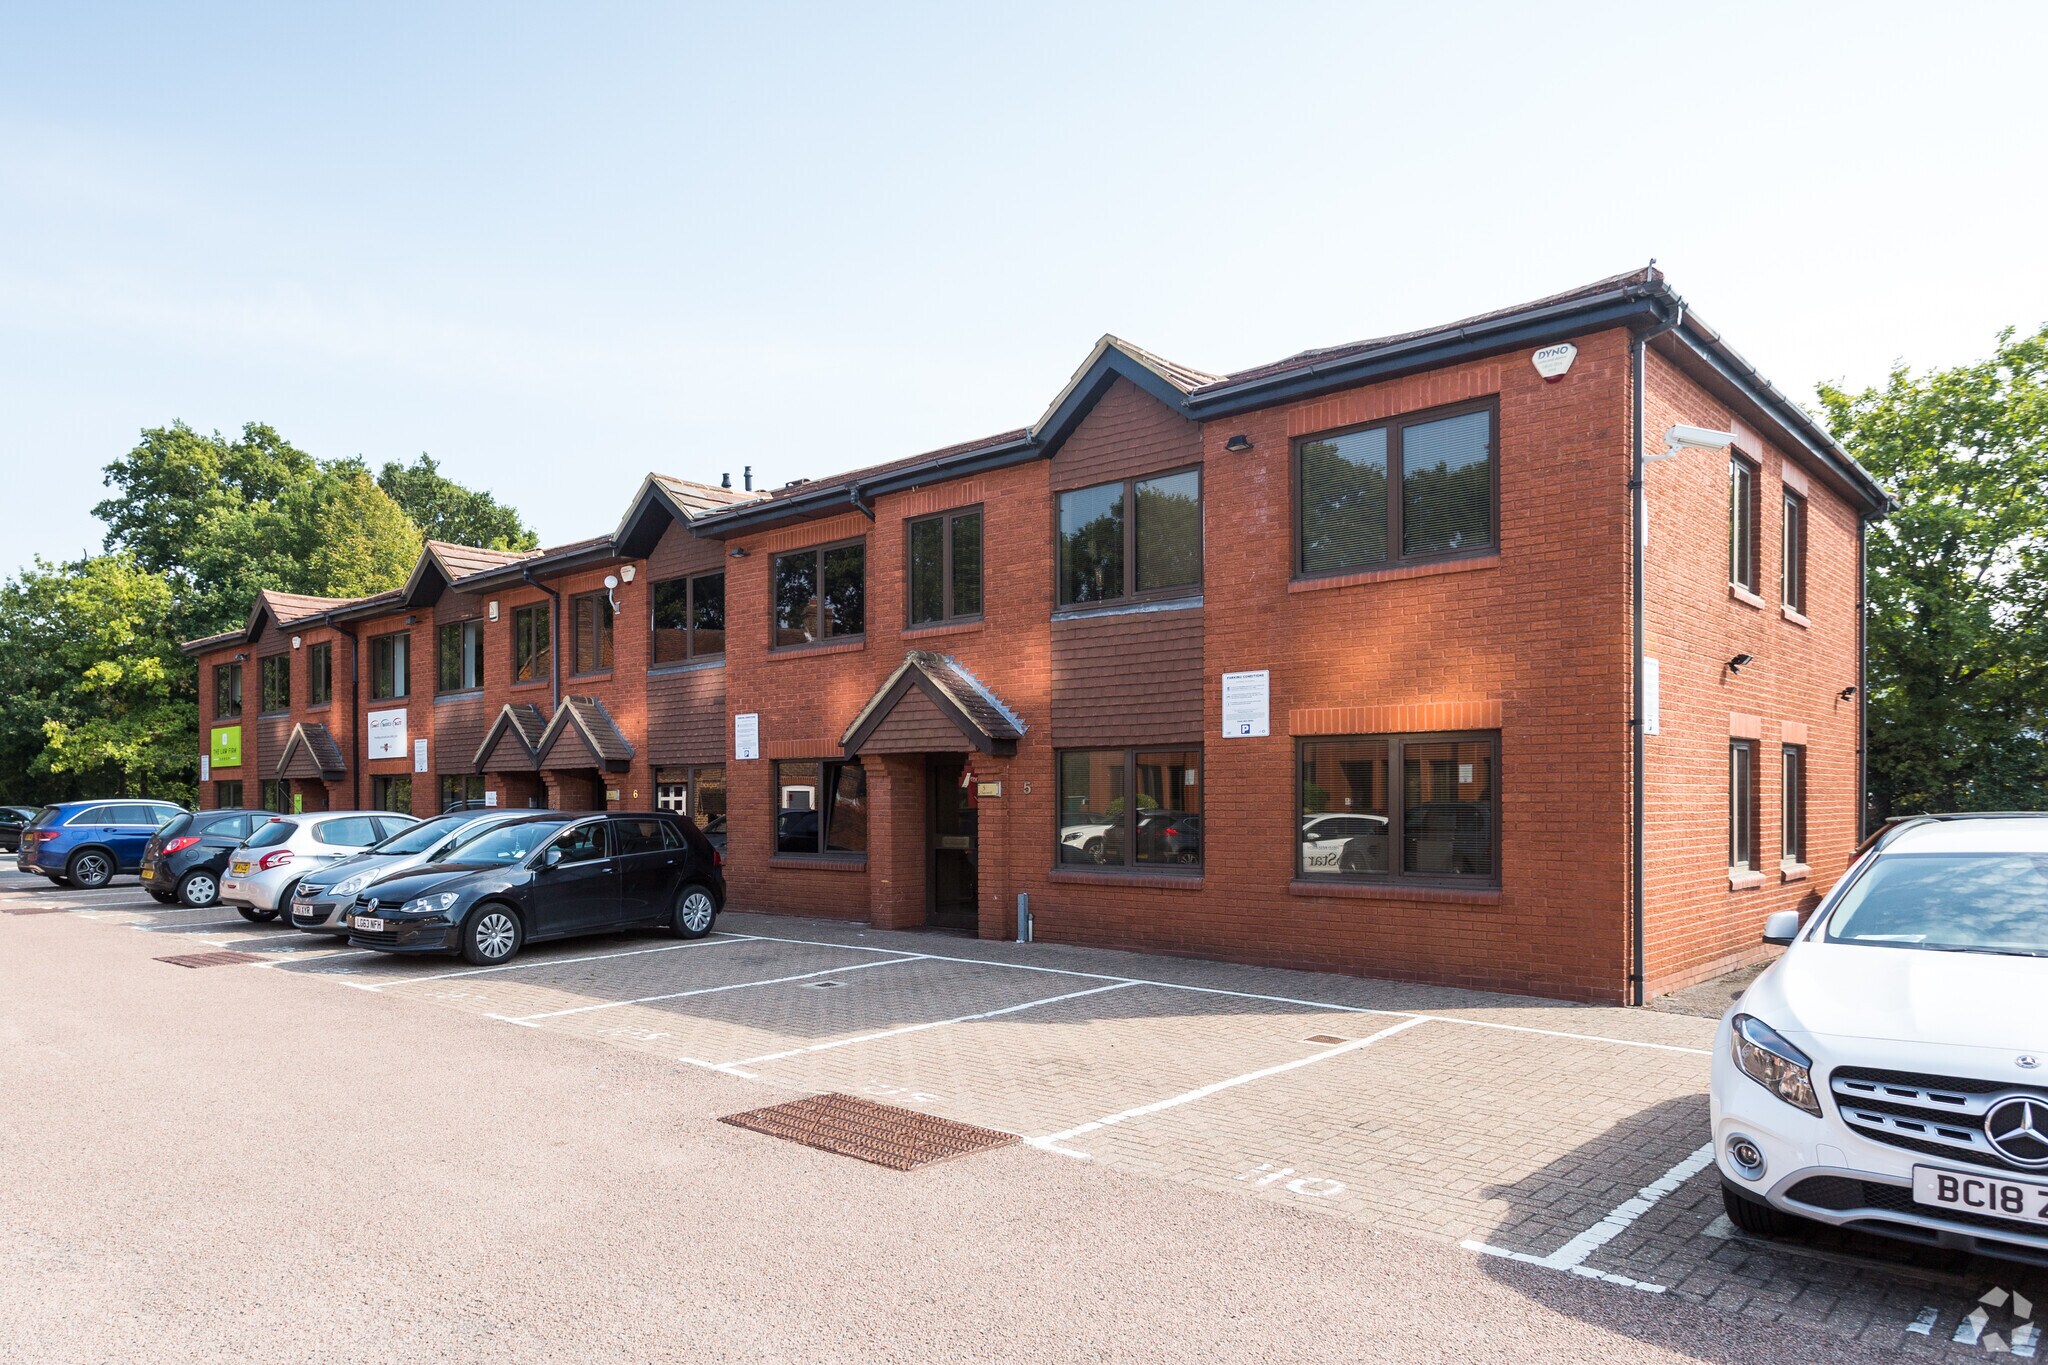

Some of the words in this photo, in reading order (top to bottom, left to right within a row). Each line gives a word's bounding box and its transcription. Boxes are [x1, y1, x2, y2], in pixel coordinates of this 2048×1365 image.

[1538, 346, 1568, 359] DYNO
[633, 789, 638, 799] 6
[1023, 781, 1031, 794] 5
[356, 918, 369, 929] LG63
[1937, 1174, 2023, 1214] BC18
